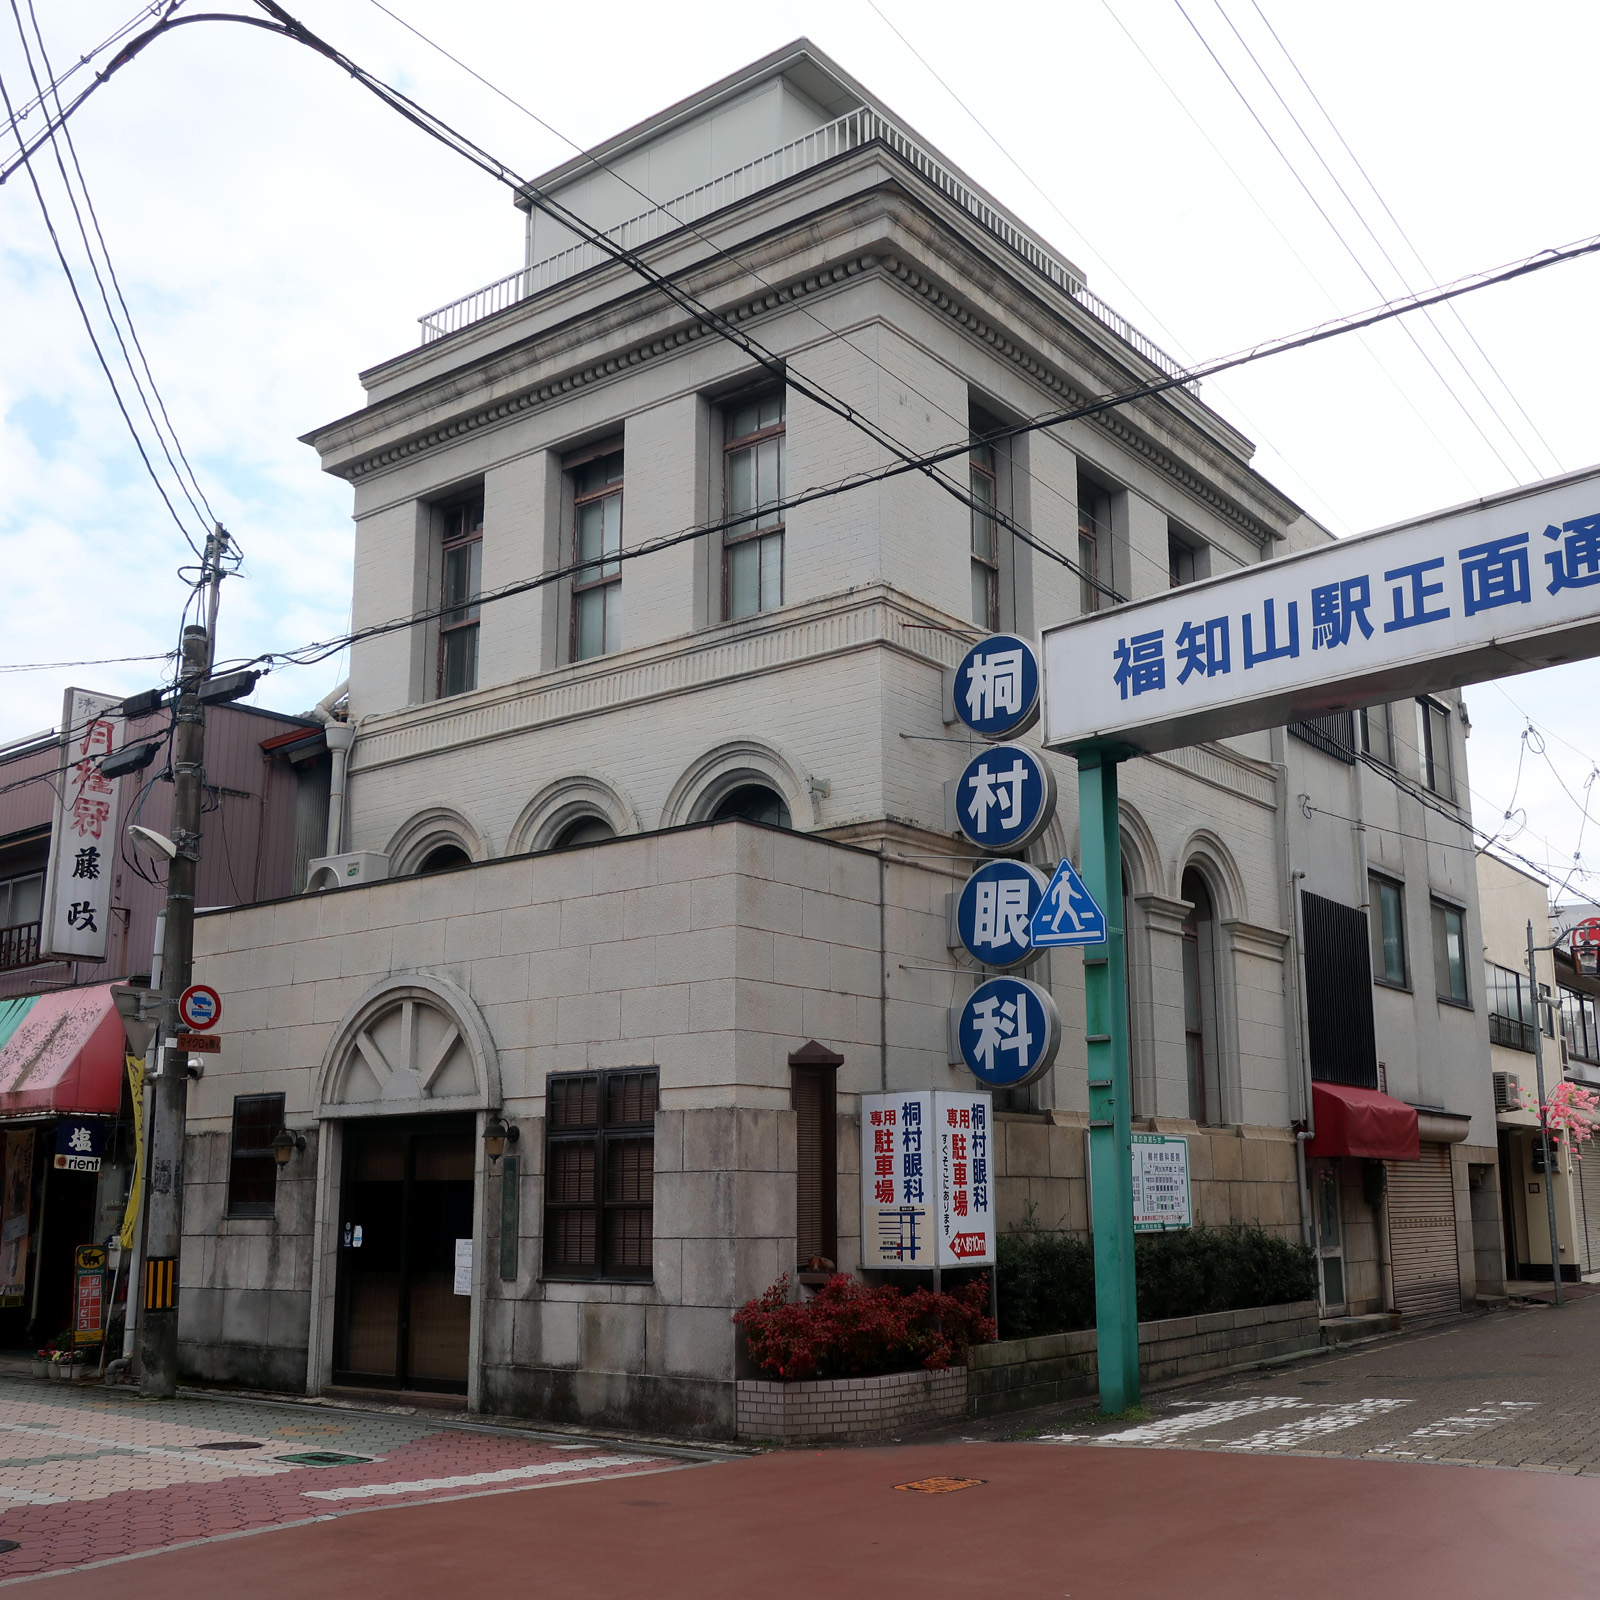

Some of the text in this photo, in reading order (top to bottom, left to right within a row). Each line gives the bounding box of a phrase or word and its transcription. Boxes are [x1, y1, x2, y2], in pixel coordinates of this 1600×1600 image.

[1113, 513, 1600, 700] 福知山駅正面通
[69, 719, 115, 840] 月桂冠
[68, 846, 101, 933] 藤政
[965, 648, 1033, 1070] 桐村眼科
[179, 1037, 220, 1049] マイクロを除く
[68, 1126, 92, 1152] 塩
[869, 1109, 897, 1127] 専用
[901, 1101, 924, 1204] 桐村眼科
[946, 1108, 970, 1129] 専用
[970, 1103, 988, 1213] 桐村眼科
[874, 1128, 895, 1204] 駐車場
[951, 1133, 968, 1217] 駐車場
[953, 1234, 986, 1254] 北へ約10m
